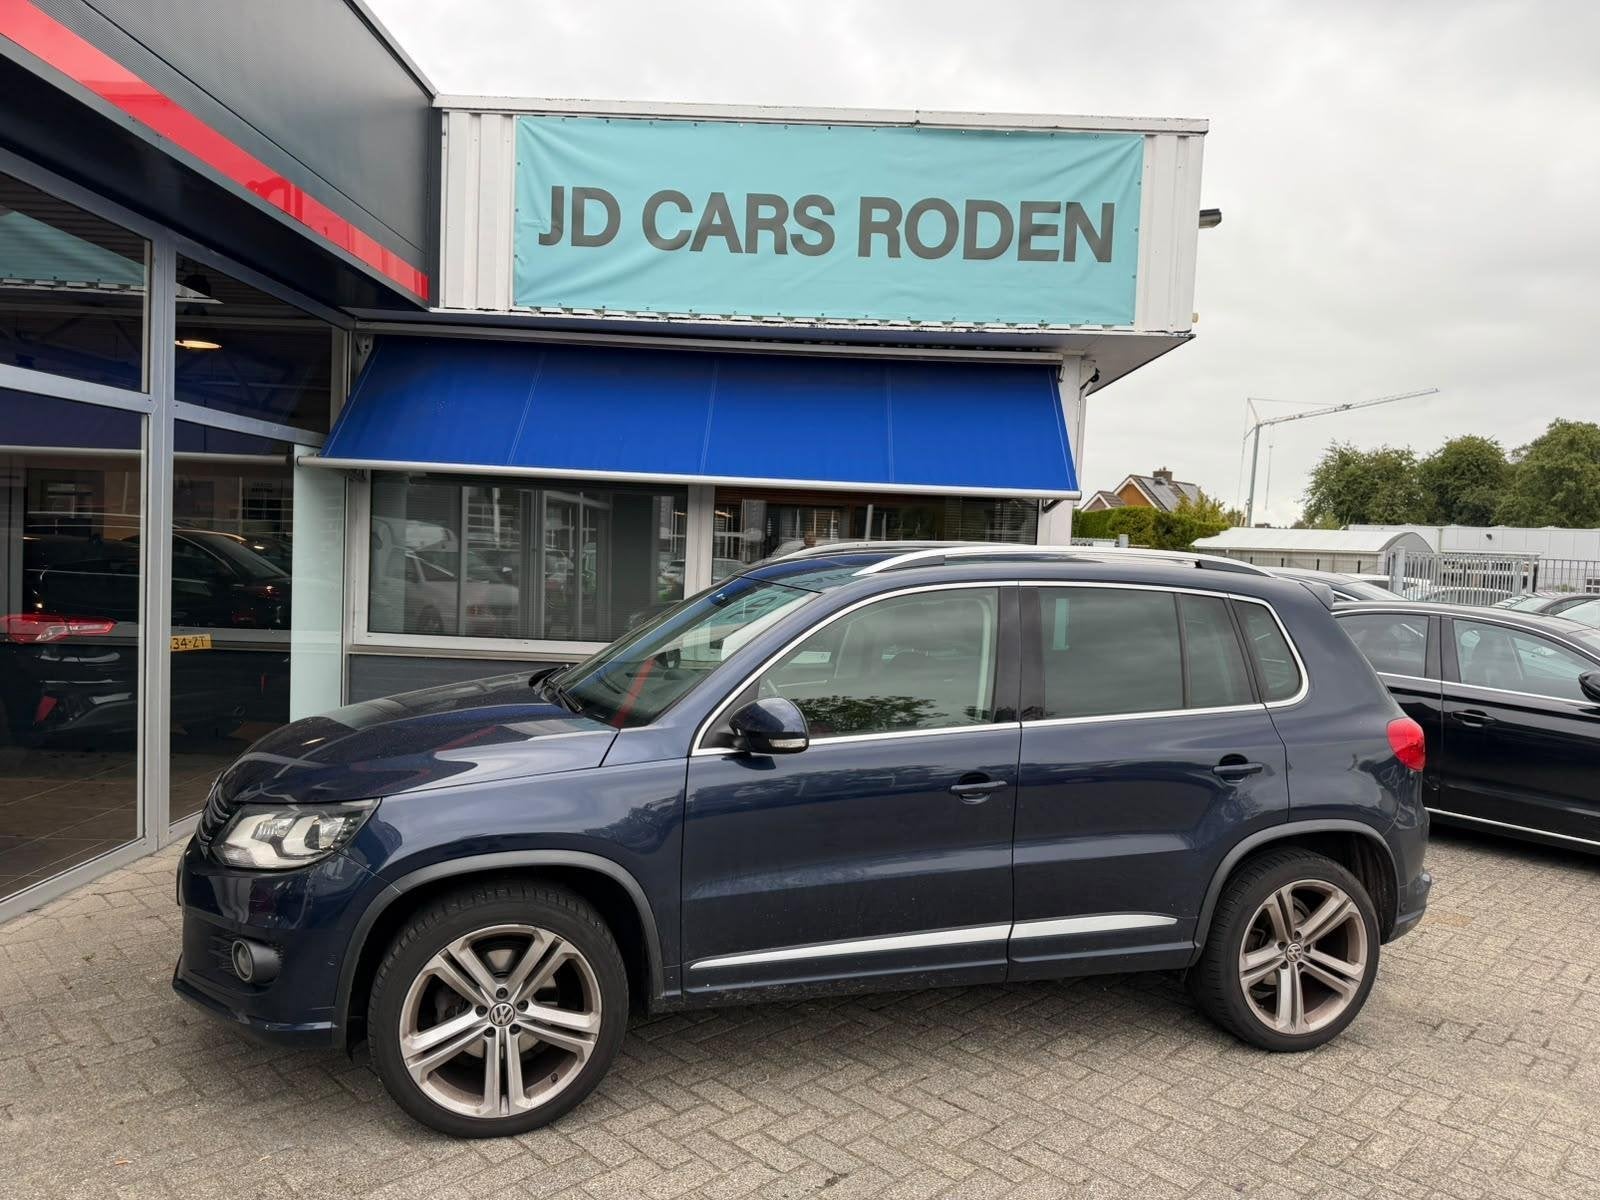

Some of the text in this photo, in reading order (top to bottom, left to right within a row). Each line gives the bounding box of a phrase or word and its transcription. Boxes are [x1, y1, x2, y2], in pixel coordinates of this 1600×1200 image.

[538, 185, 1115, 263] JD CARS RODEN
[170, 636, 205, 649] 34-ZT
[490, 1002, 514, 1027] VW
